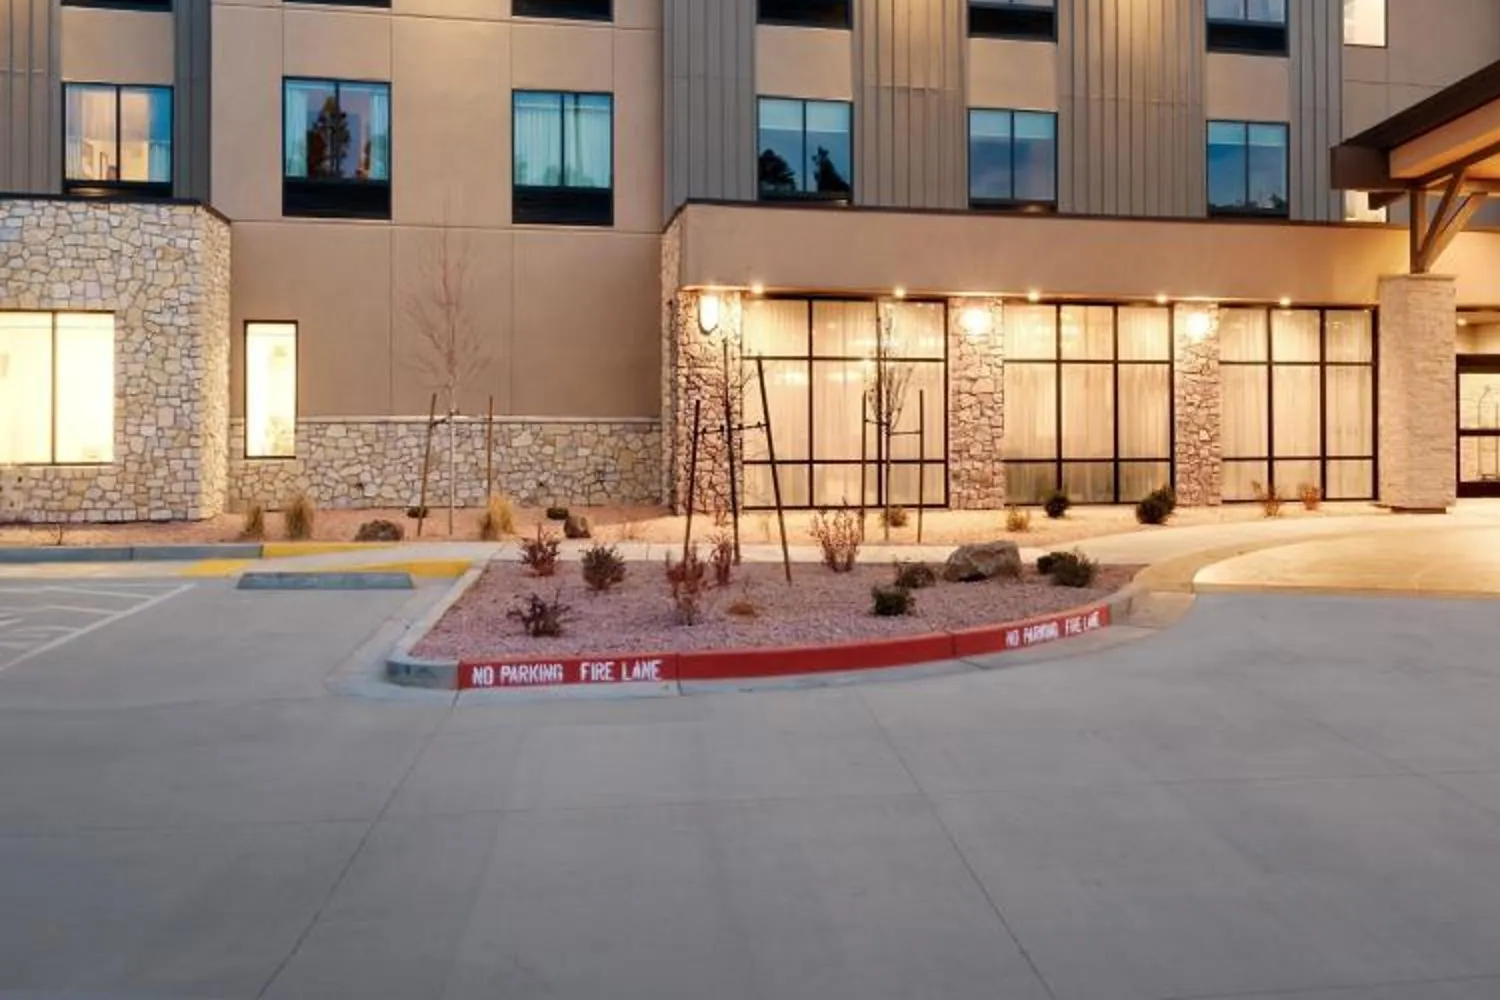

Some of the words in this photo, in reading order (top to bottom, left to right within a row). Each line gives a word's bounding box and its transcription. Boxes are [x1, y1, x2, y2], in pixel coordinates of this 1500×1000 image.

[1005, 629, 1020, 647] NO
[472, 665, 494, 685] NO
[501, 663, 564, 685] PARKING
[580, 661, 615, 681] FIRE
[621, 659, 662, 681] LANE
